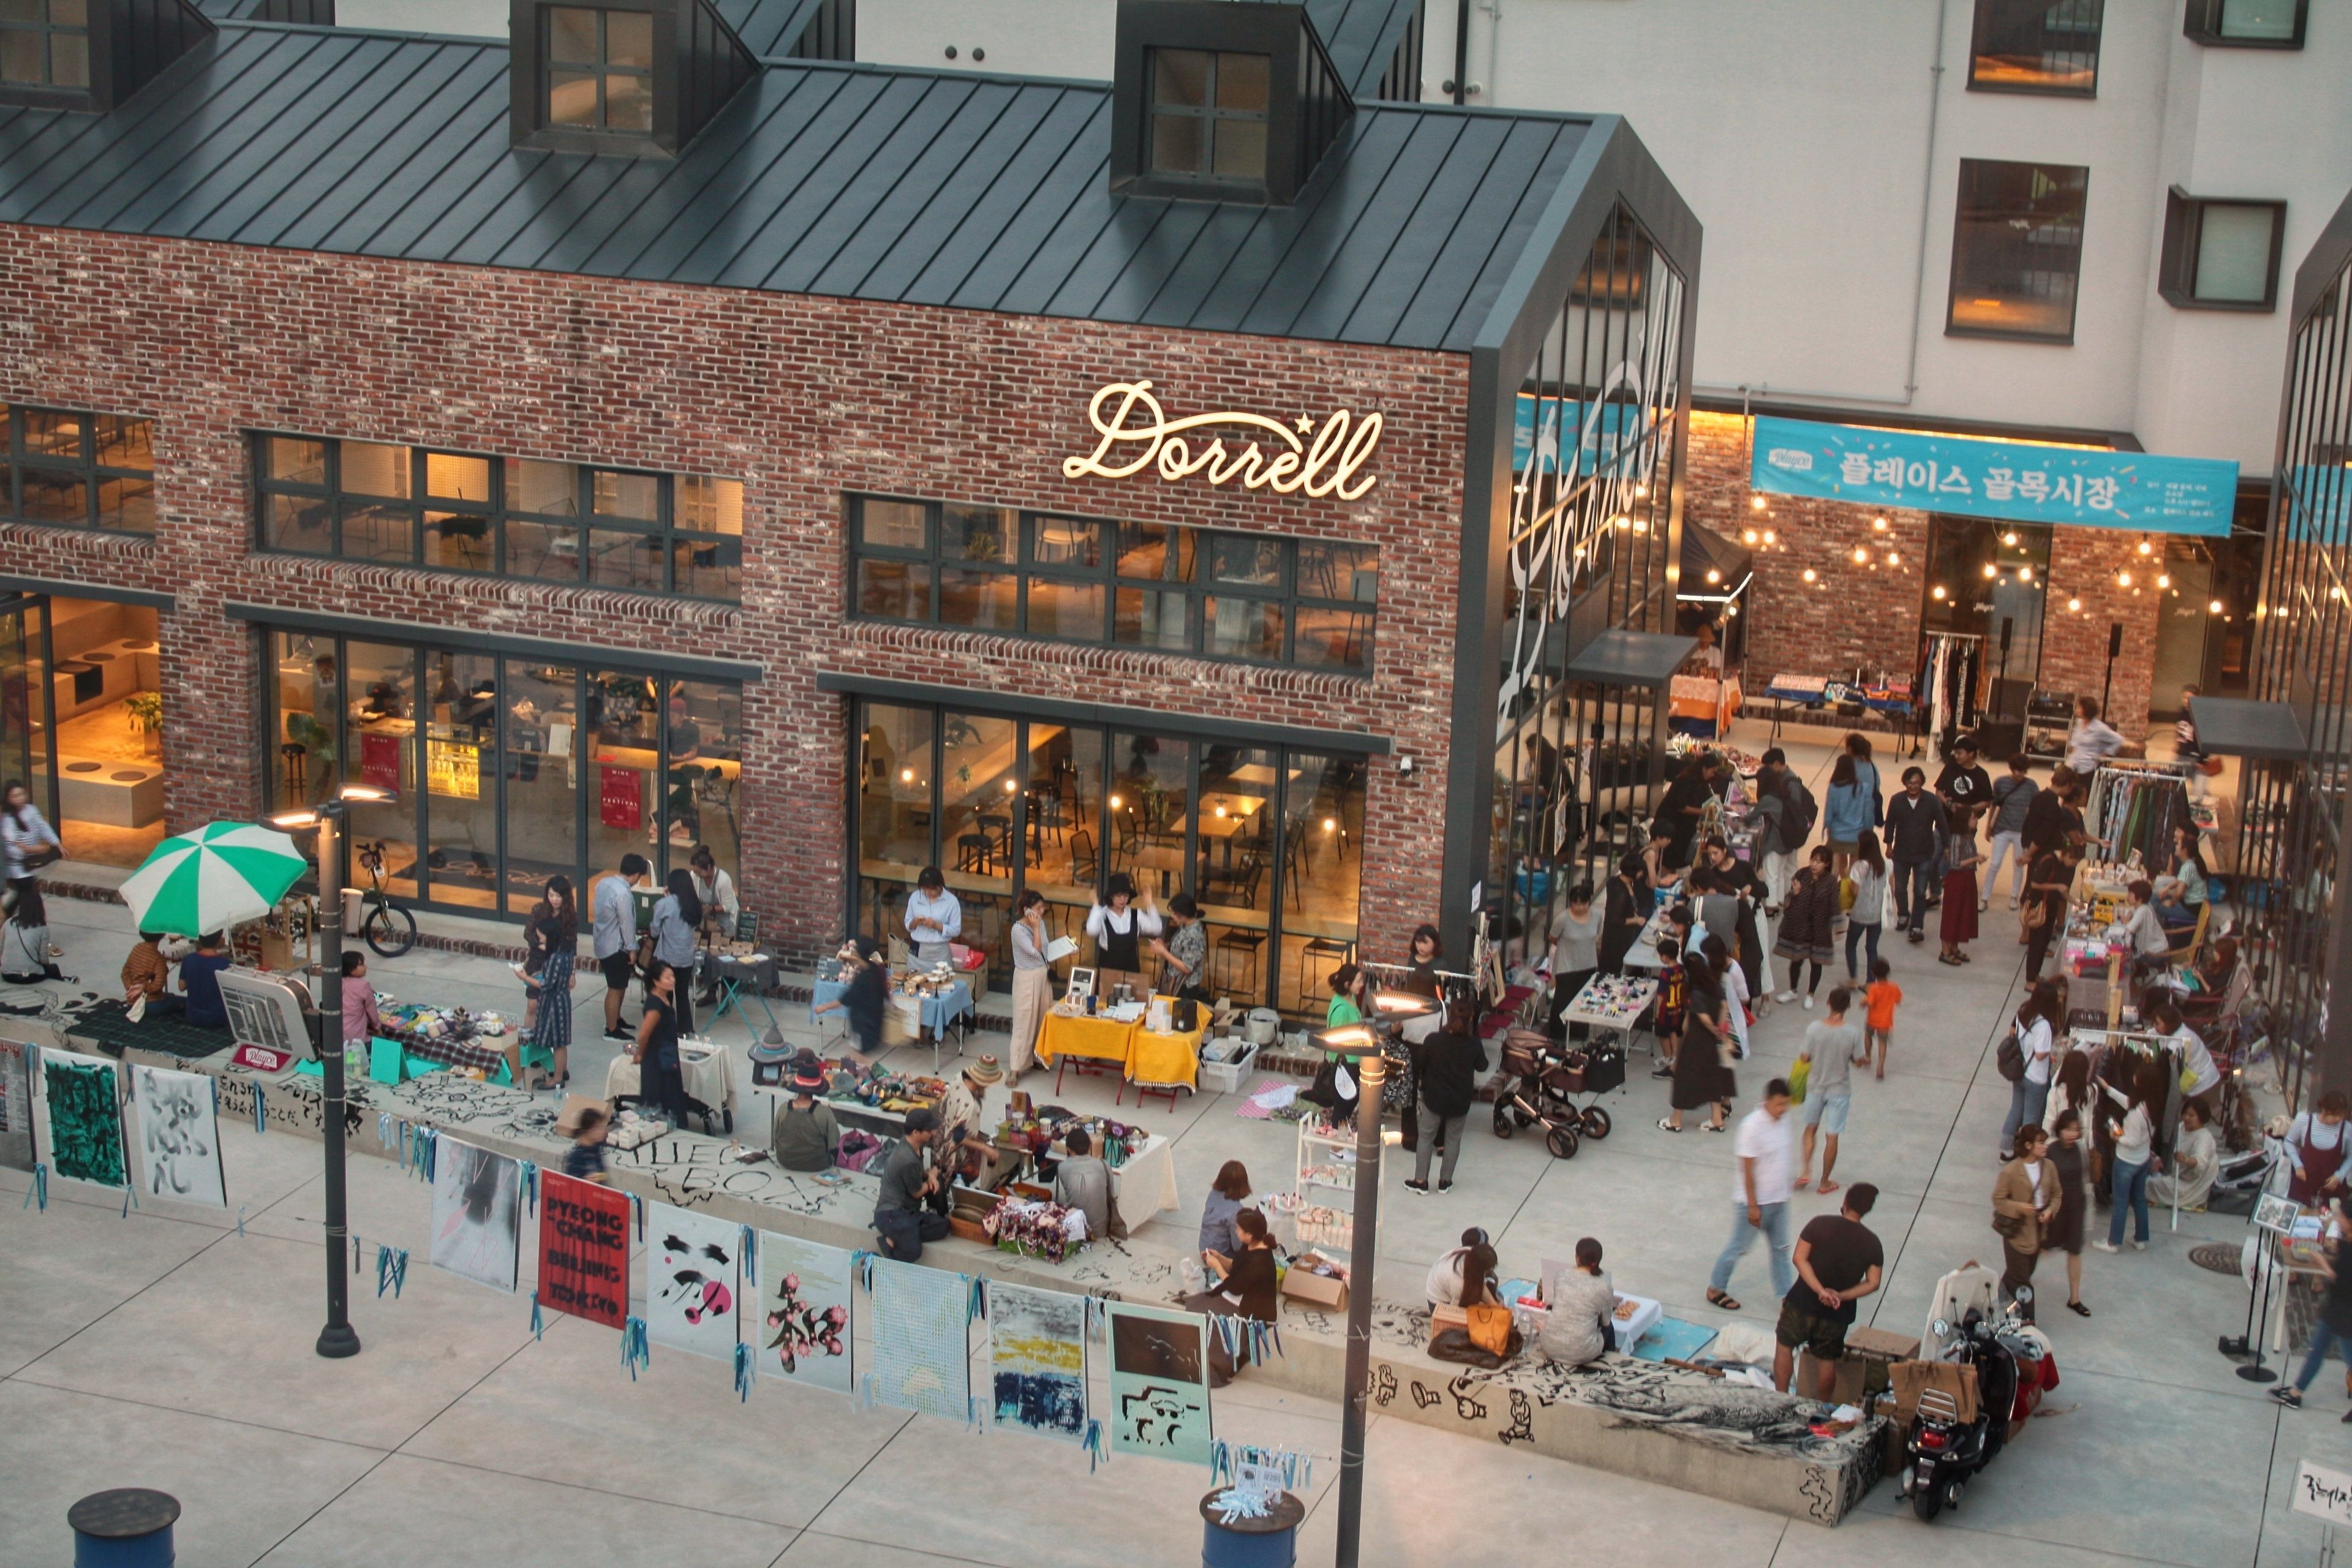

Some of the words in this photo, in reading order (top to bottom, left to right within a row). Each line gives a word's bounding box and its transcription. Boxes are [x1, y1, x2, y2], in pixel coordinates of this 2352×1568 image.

[1063, 380, 1382, 500] Dorrell
[1839, 451, 1972, 494] 플레이스
[1983, 467, 2120, 510] 골목시장
[603, 797, 638, 807] FESTIVAL
[547, 1196, 624, 1232] PYEONG
[548, 1248, 620, 1283] BEIJING
